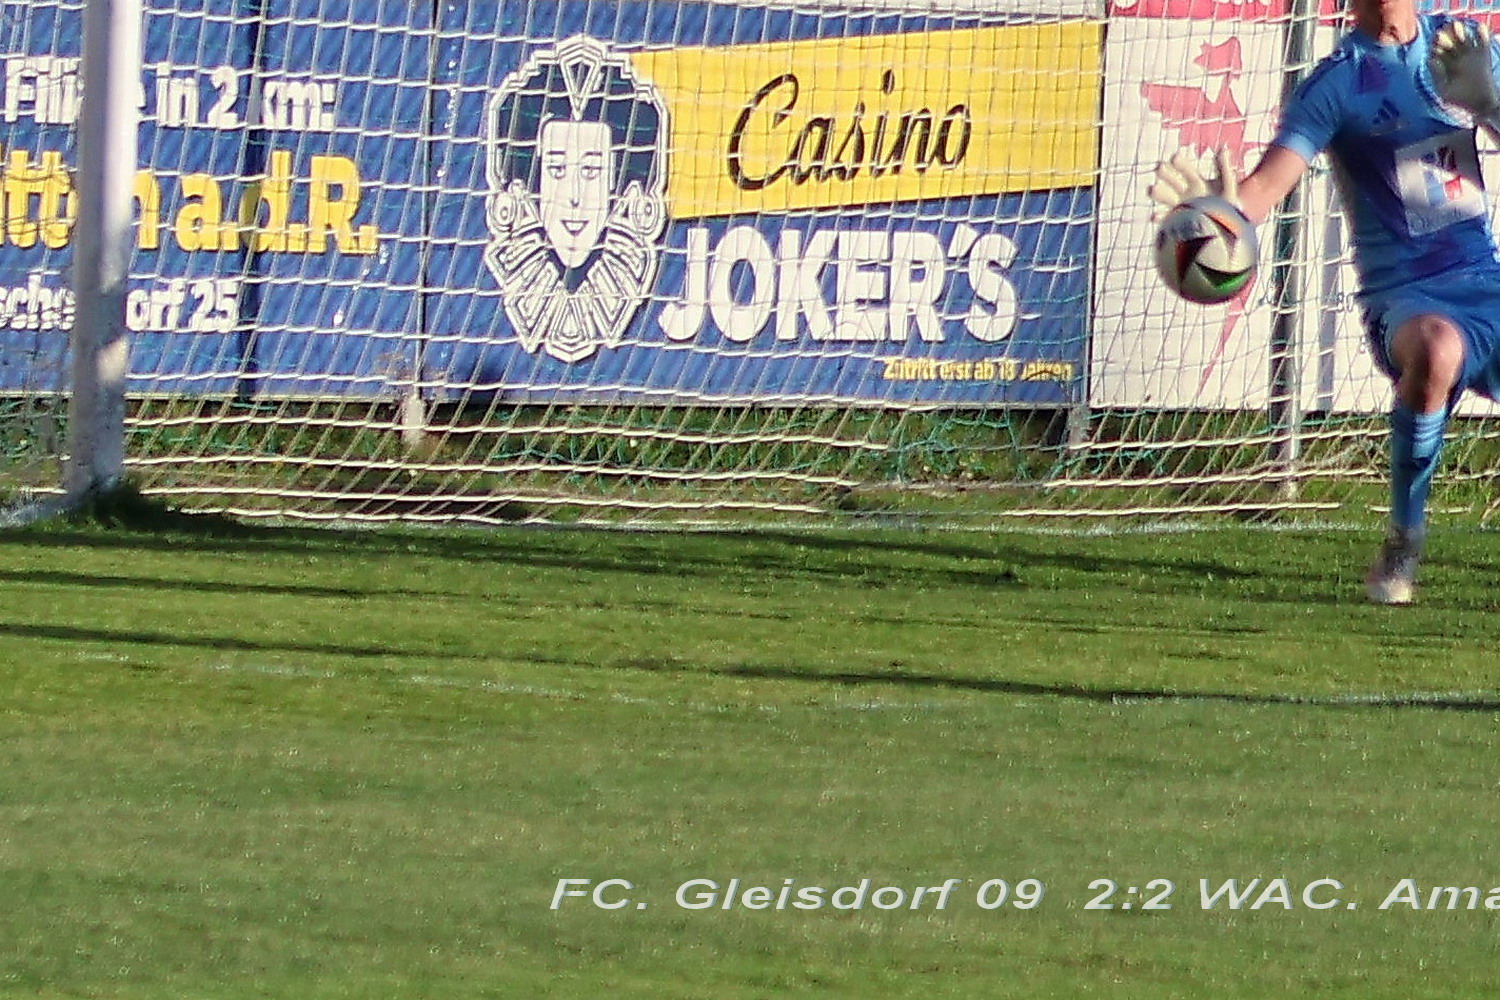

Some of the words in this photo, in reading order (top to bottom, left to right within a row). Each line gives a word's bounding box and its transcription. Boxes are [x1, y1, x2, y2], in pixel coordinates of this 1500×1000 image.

[156, 63, 199, 127] in
[207, 66, 239, 130] 2
[727, 69, 972, 192] Casino
[175, 150, 378, 255] a.d.R.
[190, 280, 238, 333] 25
[657, 223, 1020, 343] JOKER'S
